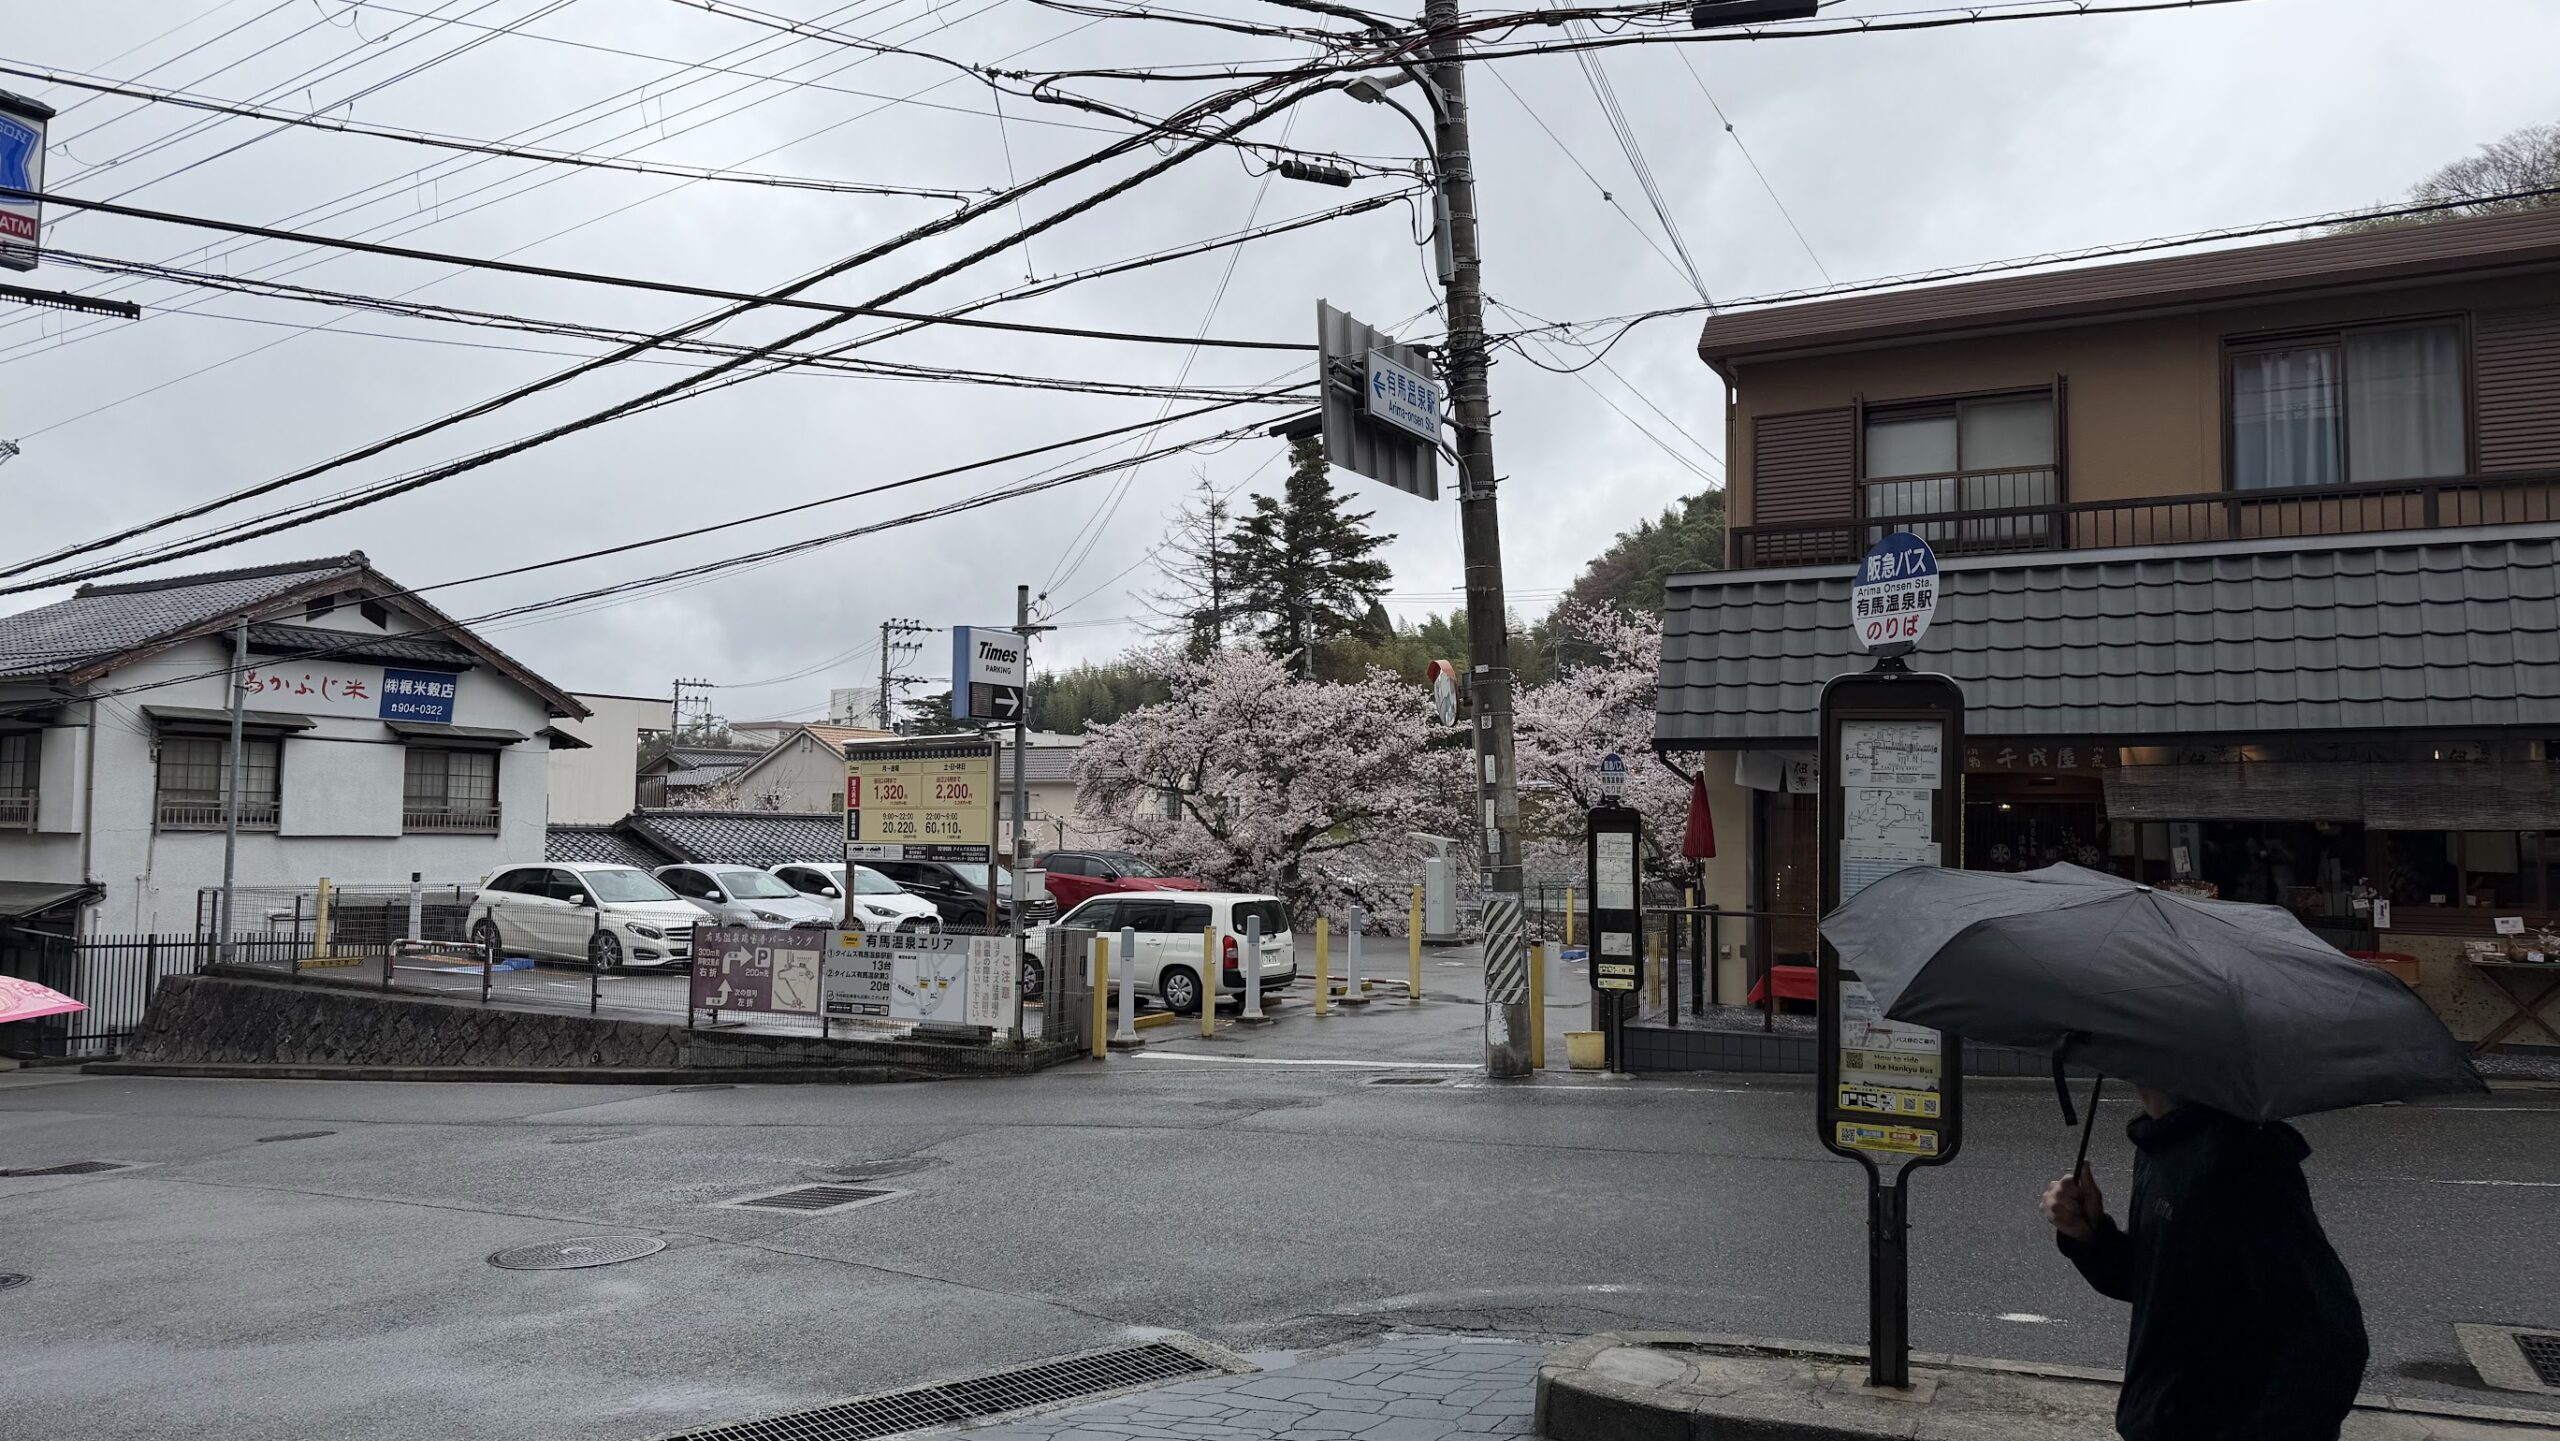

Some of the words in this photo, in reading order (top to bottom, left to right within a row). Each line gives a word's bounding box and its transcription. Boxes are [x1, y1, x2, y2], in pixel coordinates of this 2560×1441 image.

[0, 216, 32, 236] ATM
[1386, 368, 1437, 415] 有馬温泉駅
[1867, 548, 1927, 582] 阪急バス
[1857, 587, 1881, 597] Arima
[1884, 582, 1912, 593] Onsen
[1915, 578, 1932, 589] Sta.
[1856, 590, 1932, 616] 有馬温泉駅
[1867, 614, 1920, 640] のりば
[979, 641, 1018, 664] Times
[985, 664, 1011, 675] PARKING
[398, 703, 443, 715] 904-0322
[866, 934, 954, 950] 有馬温泉エリア
[757, 949, 768, 965] P
[699, 968, 717, 978] 右折
[872, 960, 892, 971] 13台
[870, 981, 890, 992] 20台
[737, 998, 754, 1008] 左折
[1888, 1064, 1917, 1073] Hankyu
